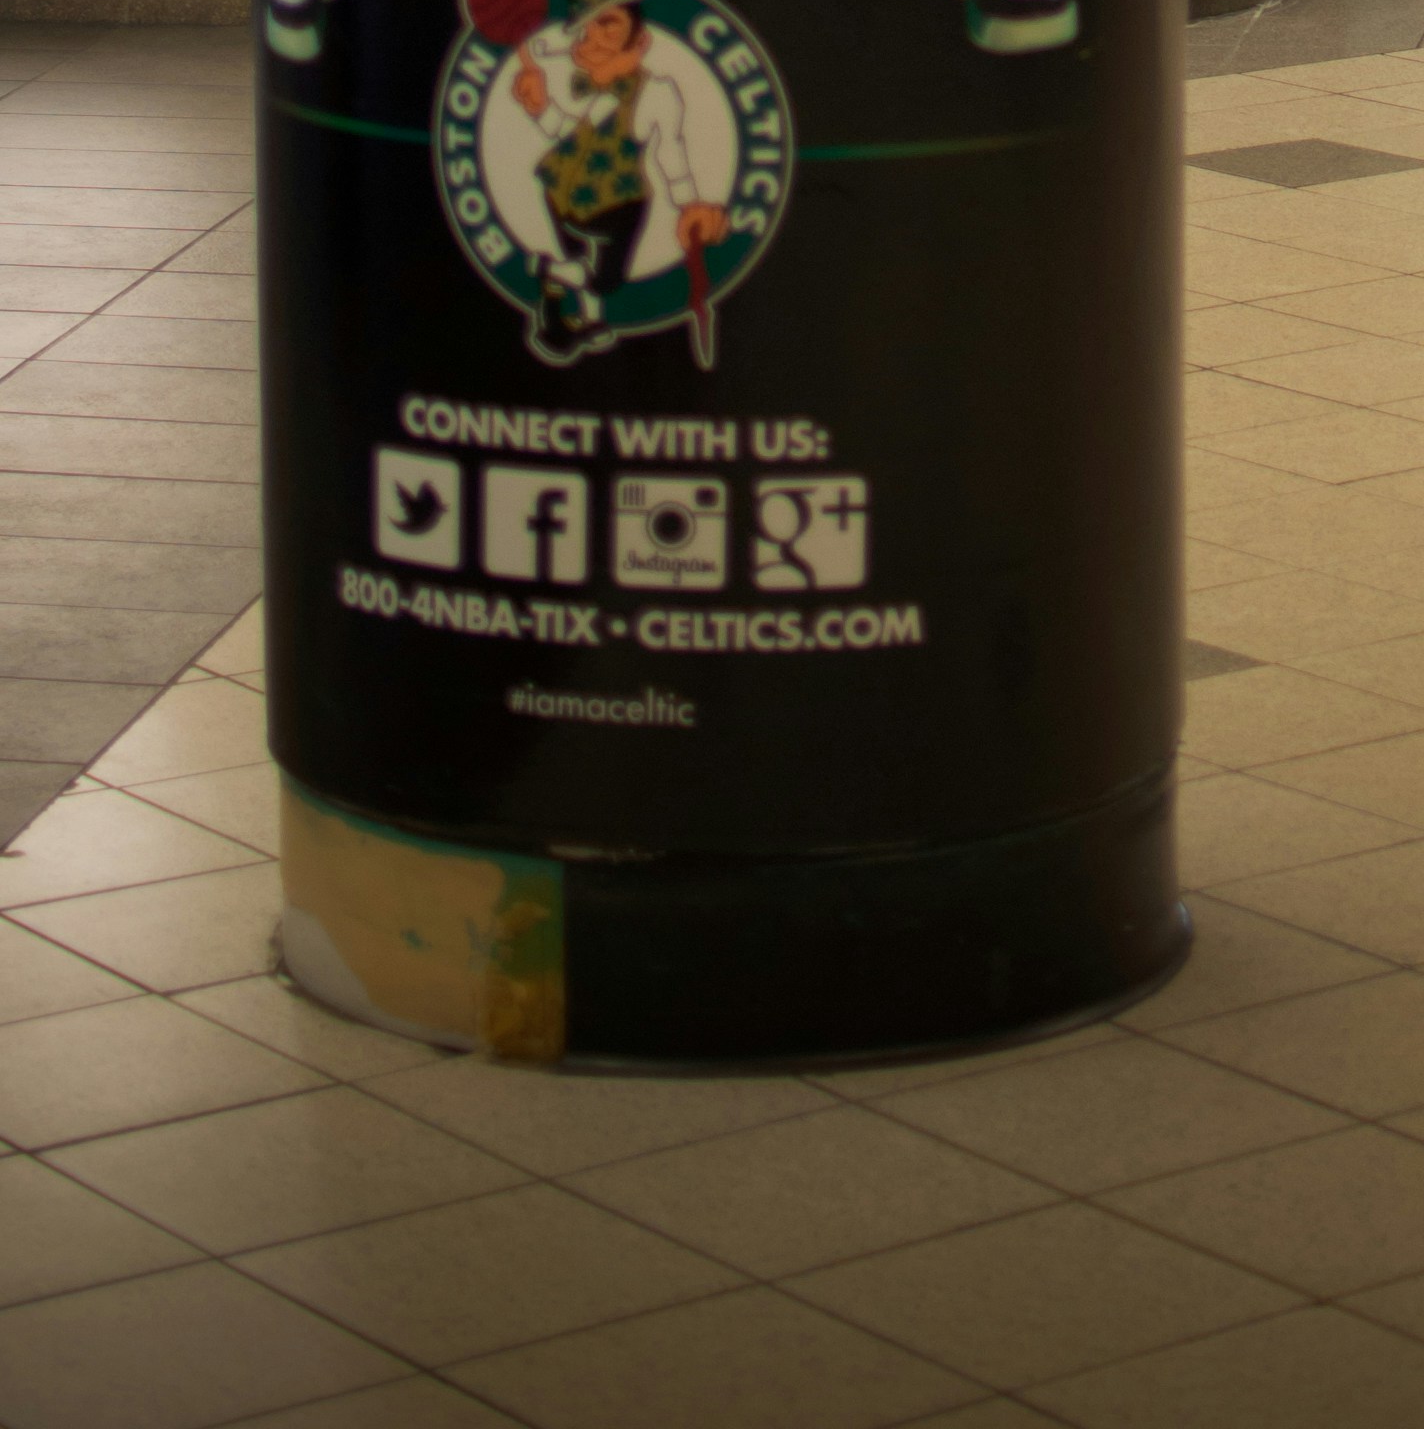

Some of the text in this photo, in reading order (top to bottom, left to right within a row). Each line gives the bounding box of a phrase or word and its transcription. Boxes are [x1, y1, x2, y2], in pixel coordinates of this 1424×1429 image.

[446, 42, 513, 270] BOSTON
[688, 12, 783, 237] CELTICS
[403, 396, 829, 461] CONNECT WITH US:
[338, 568, 924, 651] 800-4NBA-TIX CELTICS.COM
[508, 681, 696, 729] #iamaceltic
